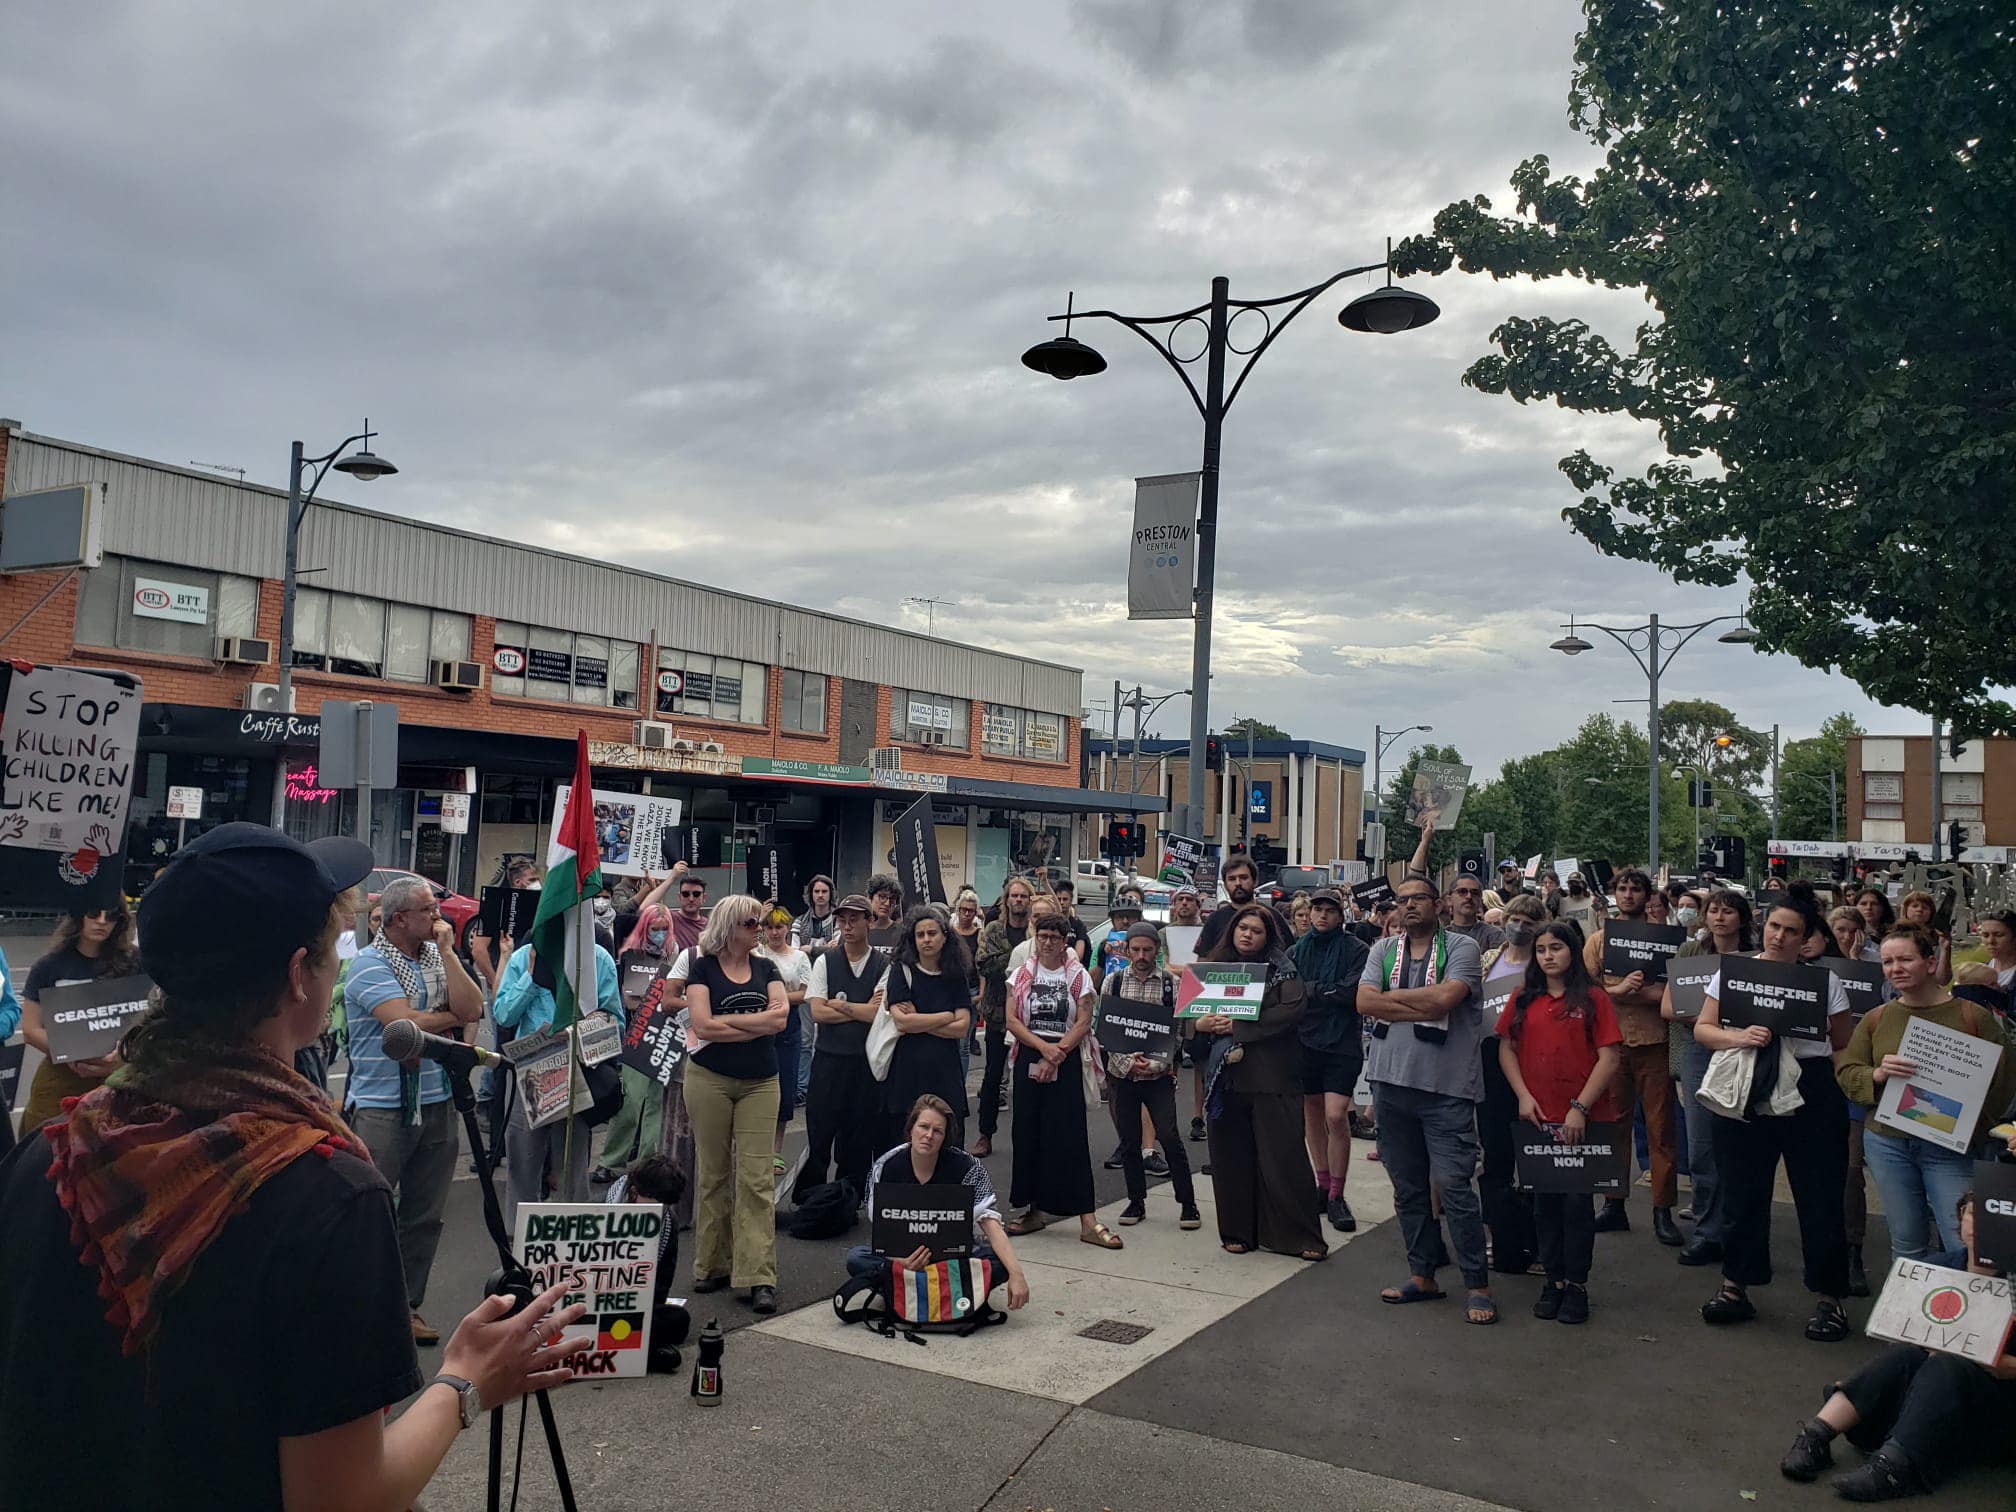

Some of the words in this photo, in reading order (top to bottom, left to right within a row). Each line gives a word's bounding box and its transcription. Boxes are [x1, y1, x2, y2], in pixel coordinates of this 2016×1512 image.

[1136, 525, 1191, 544] PRESTON
[1146, 542, 1177, 551] CENTRAL
[144, 592, 163, 602] BTT
[178, 594, 200, 606] BTT
[499, 653, 519, 664] BTT
[662, 675, 678, 685] BTT
[26, 691, 120, 726] STOP
[911, 704, 931, 716] MAIOLO
[284, 716, 320, 740] Rust
[16, 728, 120, 761] KILLING
[6, 758, 129, 787] CHILDREN
[772, 760, 794, 768] MAIOLO
[794, 762, 798, 770] &
[830, 766, 850, 774] MAIOLO
[1423, 764, 1442, 774] SOUL
[285, 765, 318, 787] eauty
[875, 768, 914, 782] MAIOLO
[918, 774, 926, 784] &
[284, 782, 338, 804] Massage
[78, 794, 120, 819] ME!
[637, 814, 646, 829] THE
[645, 829, 653, 842] WE
[651, 806, 663, 860] JOURNALISTS
[633, 832, 643, 858] TRUTH
[1177, 841, 1194, 852] FREE
[640, 844, 650, 871] KNOW
[1166, 846, 1200, 863] PALESTINE
[762, 868, 770, 886] NOW
[770, 850, 779, 902] CEASEFIRE
[912, 858, 922, 894] NOW
[1610, 937, 1678, 954] CEASEFIRE
[1629, 950, 1654, 960] NOW
[1206, 972, 1250, 983] CEASEFIRE
[1226, 986, 1244, 994] NOW
[1728, 979, 1818, 1002] CEASEFIRE
[1218, 1006, 1255, 1014] PALESTINE
[1753, 996, 1785, 1010] NOW
[54, 1000, 150, 1024] CEASEFIRE
[626, 978, 667, 1050] GENOCIDE
[88, 1016, 121, 1032] NOW
[1105, 1014, 1170, 1035] CEASEFIRE
[1922, 1028, 1936, 1036] YOU
[1124, 1027, 1148, 1040] NOW
[1908, 1040, 1922, 1048] ARE
[1924, 1044, 1950, 1056] SILENT
[1950, 1053, 1962, 1062] ON
[1962, 1058, 1982, 1068] GAZA
[1911, 1032, 1942, 1046] UKRAINE
[1944, 1044, 1963, 1054] FLAG
[1966, 1052, 1981, 1060] BUT
[657, 1050, 681, 1086] THAT
[1948, 1068, 1970, 1079] BIGOT
[1523, 1145, 1612, 1155] CEASEFIRE
[1554, 1157, 1584, 1168] NOW
[881, 1208, 965, 1221] CEASEFIRE
[524, 1213, 604, 1242] DEAFIES
[605, 1211, 661, 1238] LOUD
[909, 1222, 938, 1233] NOW
[524, 1244, 558, 1266] FOR
[565, 1240, 645, 1262] JUSTICE
[1898, 1261, 1936, 1282] LET
[1969, 1278, 2010, 1298] GAZ
[594, 1292, 638, 1311] FREE
[1901, 1318, 1980, 1356] LIVE
